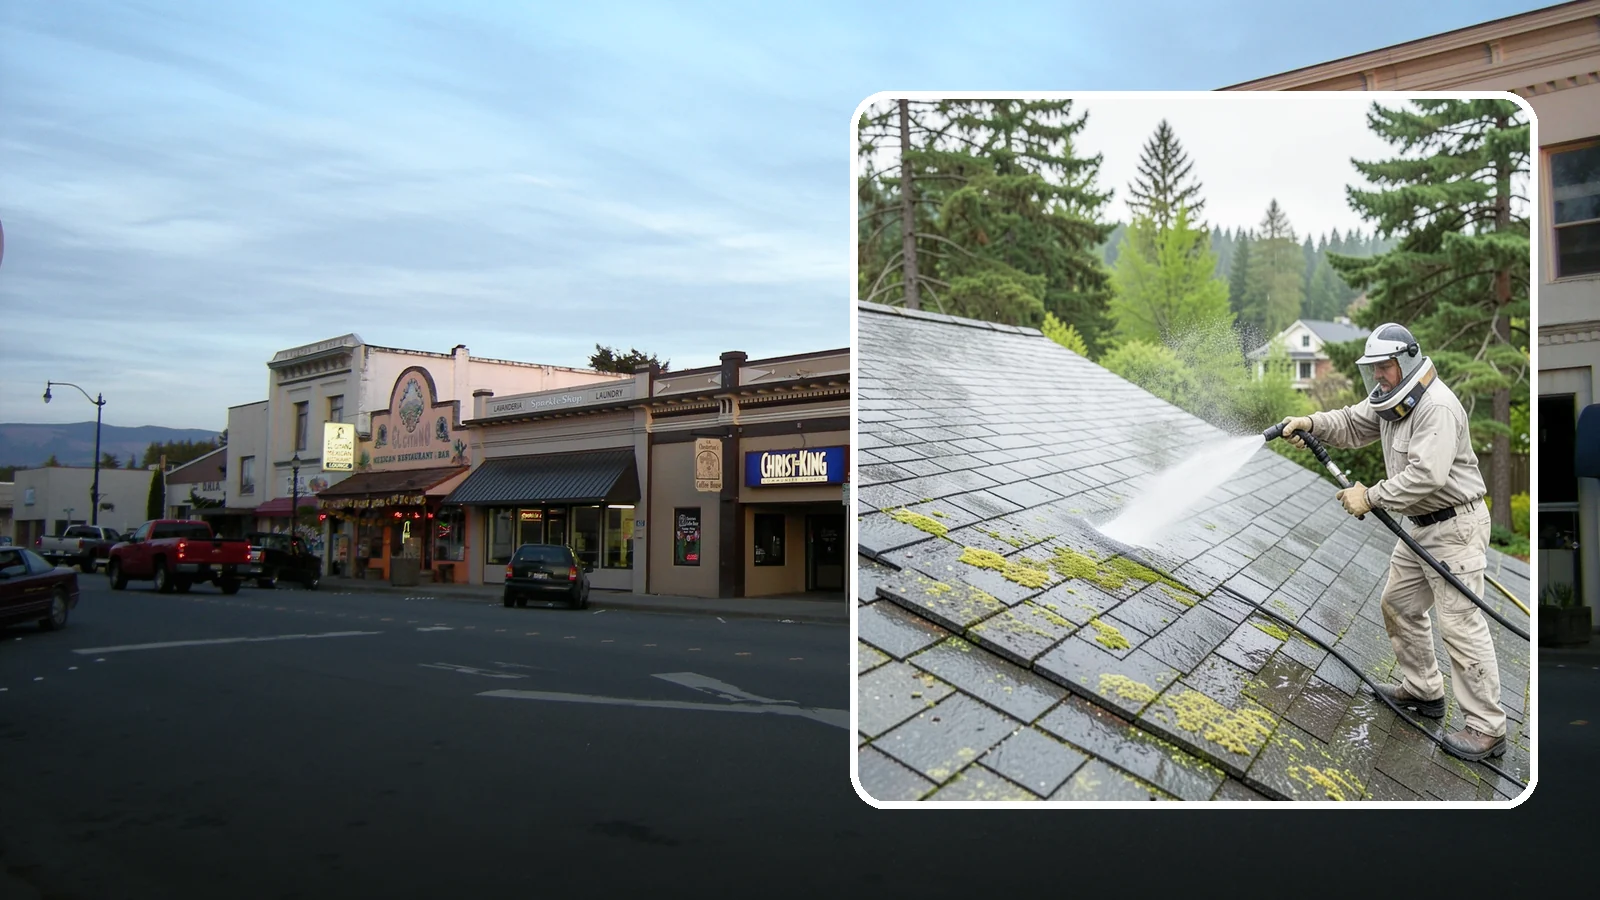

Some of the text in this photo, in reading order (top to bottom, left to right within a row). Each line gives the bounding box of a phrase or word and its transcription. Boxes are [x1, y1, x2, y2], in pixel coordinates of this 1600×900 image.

[595, 389, 623, 400] LAUNDRY
[561, 395, 582, 405] Shop
[493, 402, 522, 412] LAVANDERIA
[373, 455, 396, 464] MEXICAN
[397, 451, 433, 462] RESTAURANT
[438, 450, 450, 459] BAR
